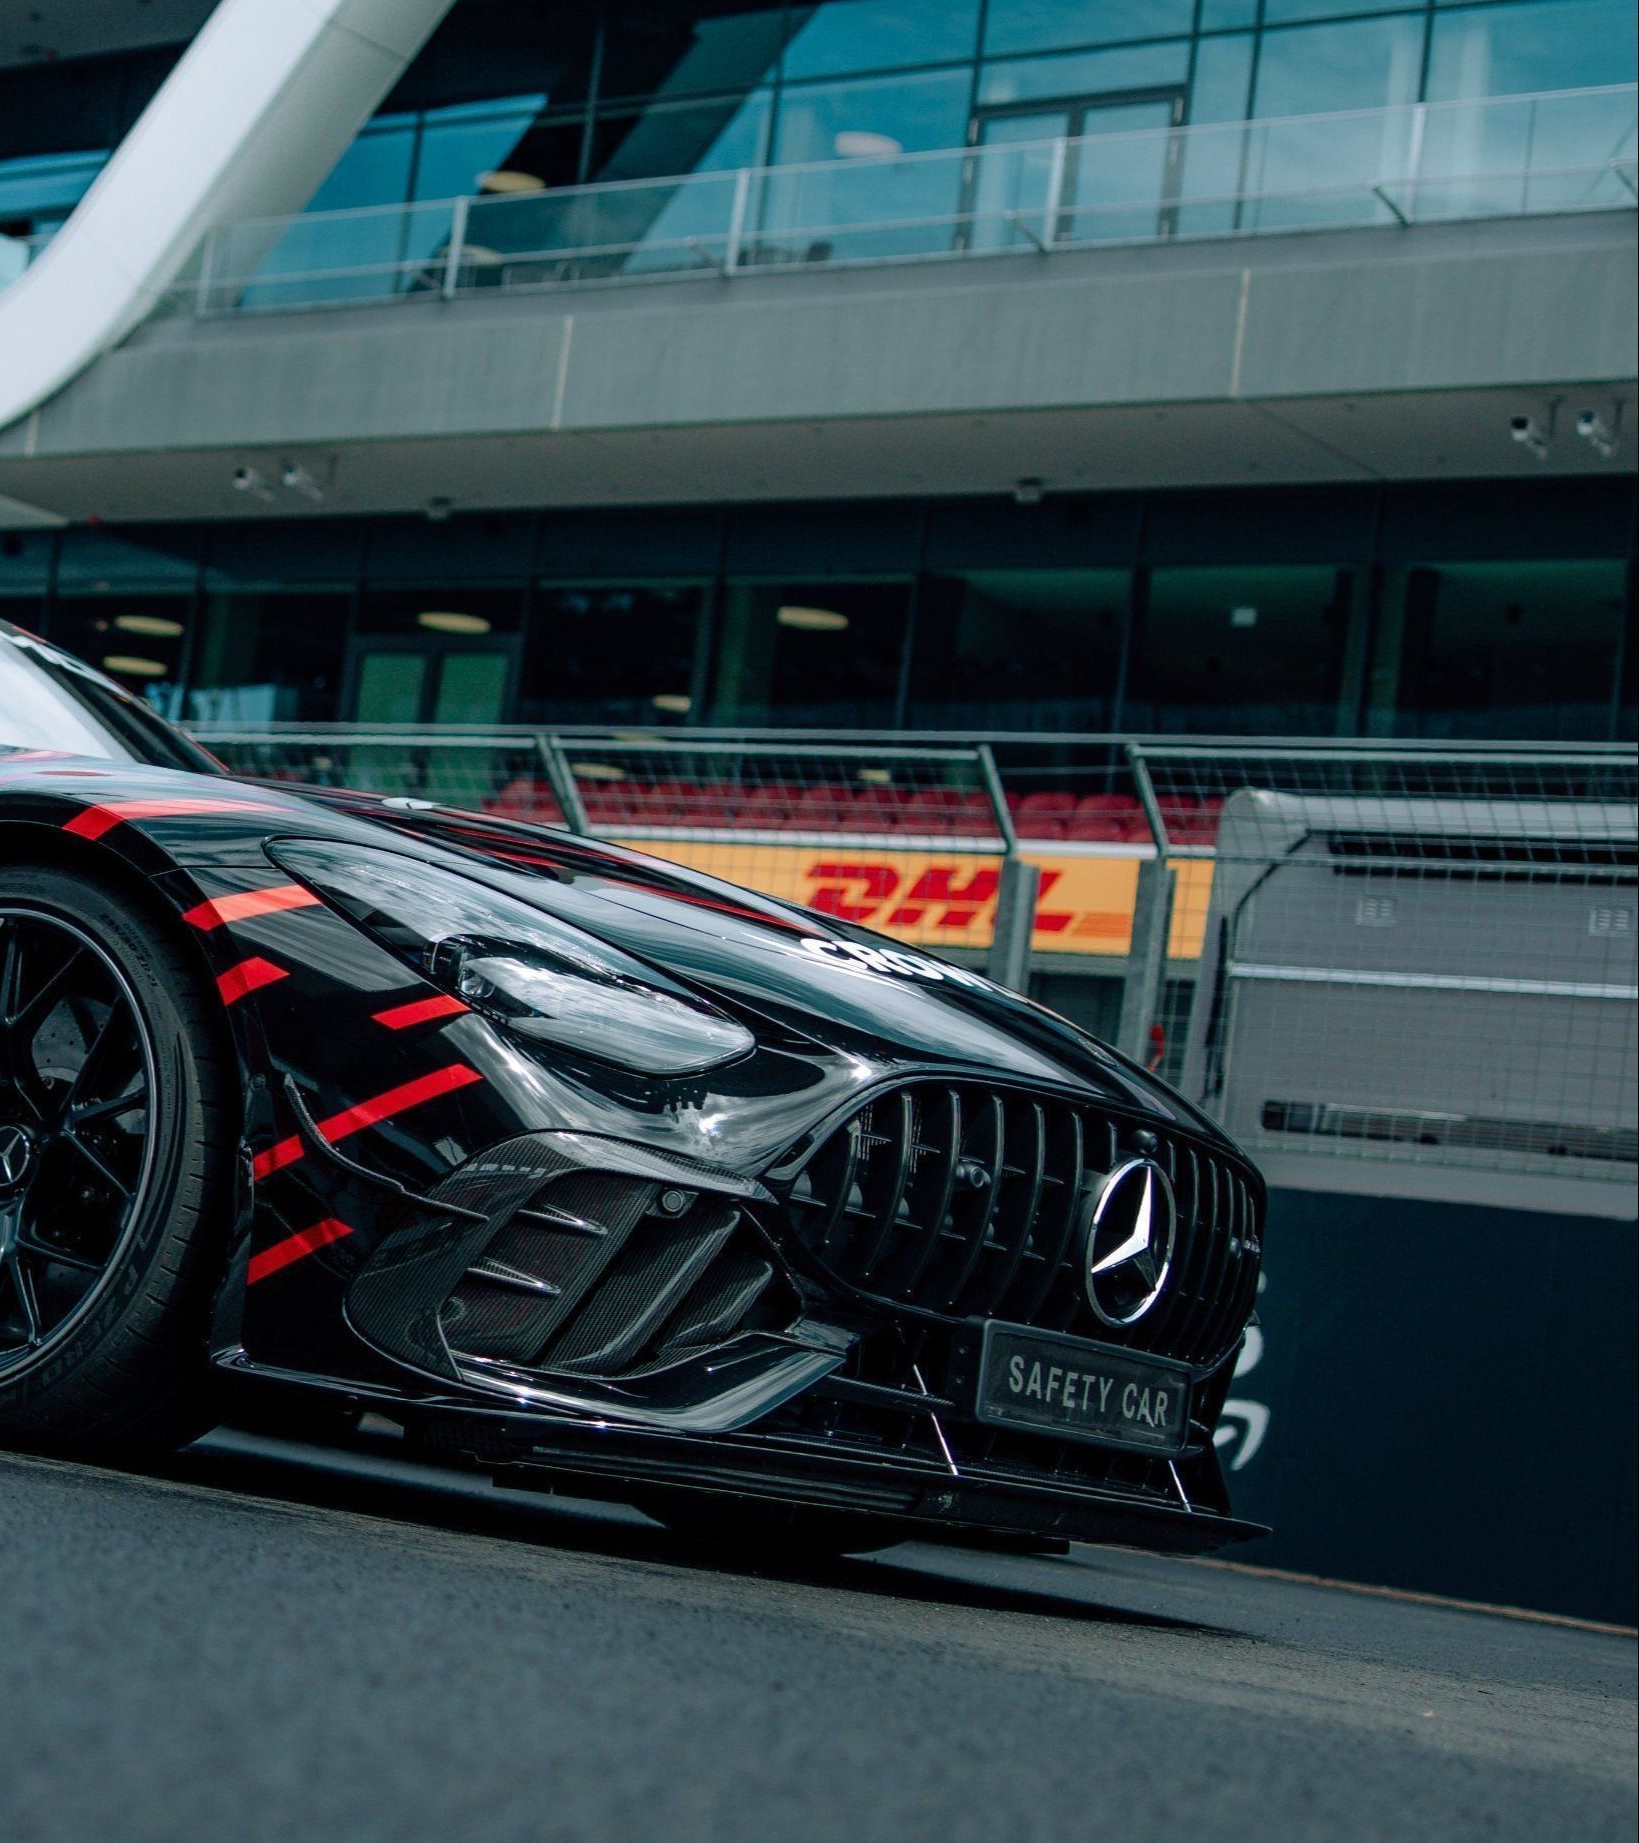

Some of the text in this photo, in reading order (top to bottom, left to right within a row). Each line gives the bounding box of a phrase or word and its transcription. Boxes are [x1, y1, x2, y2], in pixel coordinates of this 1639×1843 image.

[805, 864, 1074, 933] DHL
[1008, 1354, 1168, 1428] SAFETY CAR
